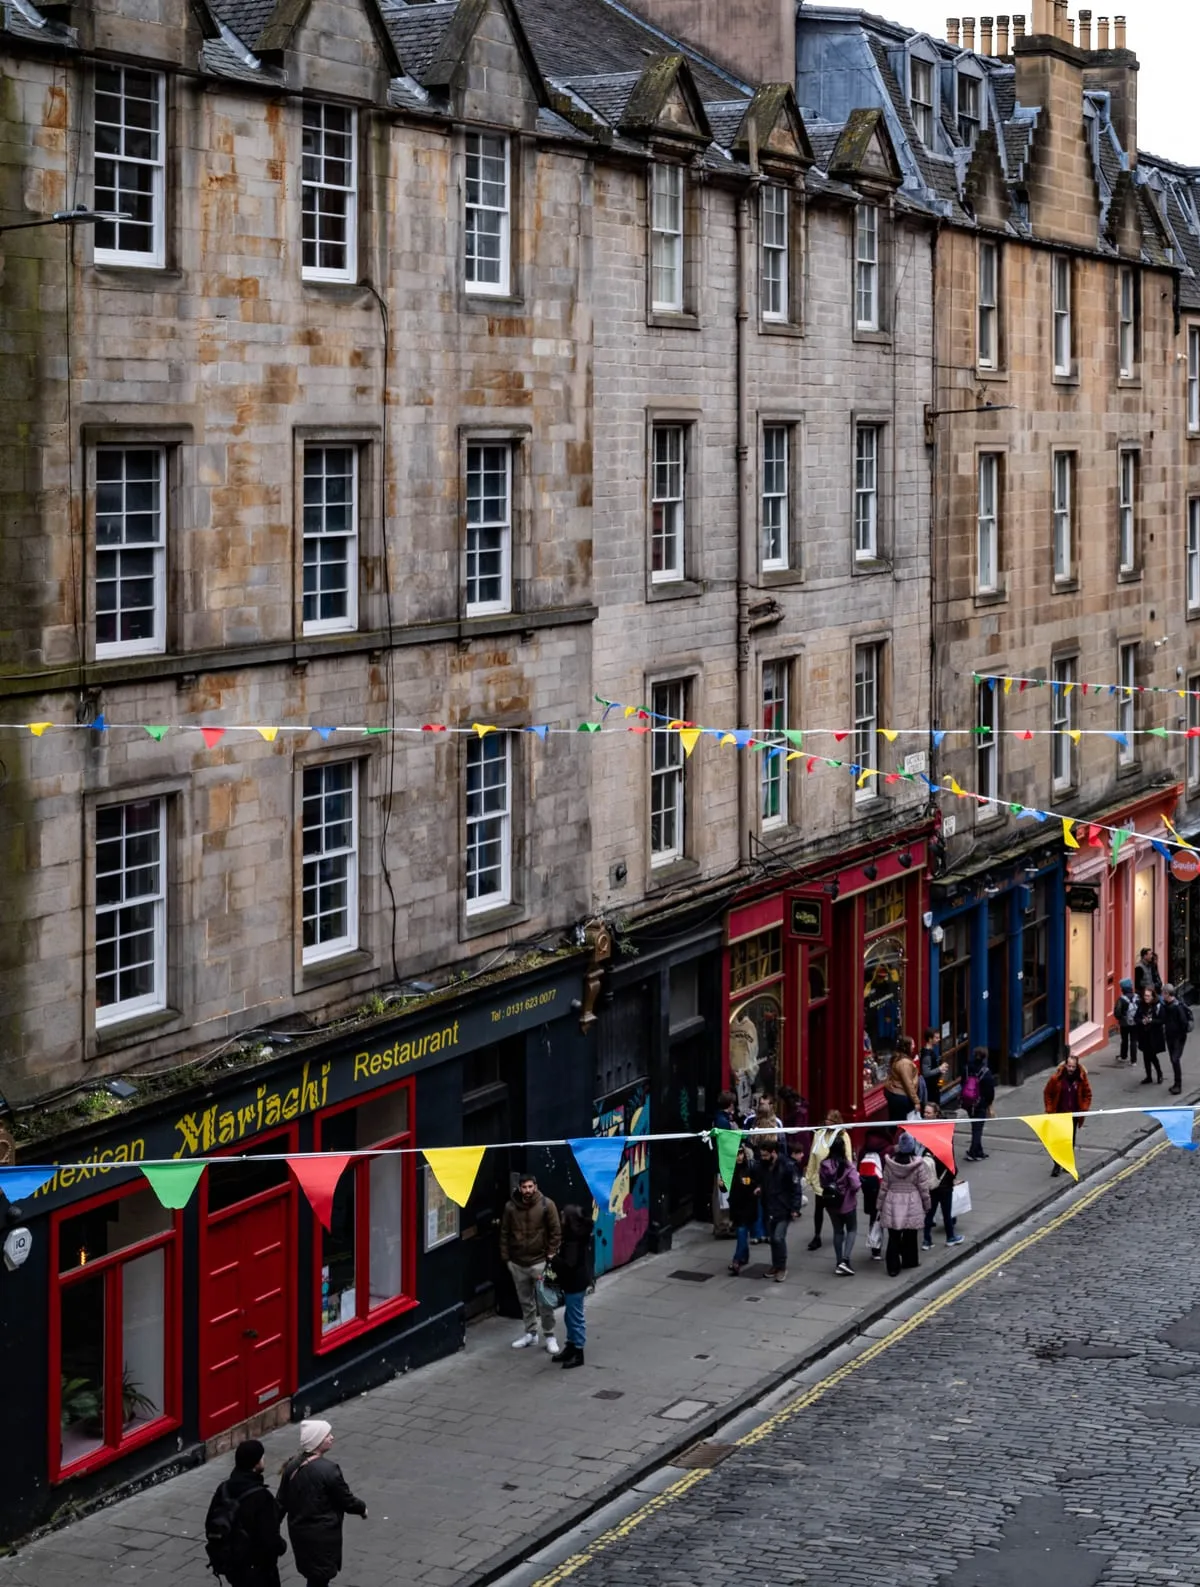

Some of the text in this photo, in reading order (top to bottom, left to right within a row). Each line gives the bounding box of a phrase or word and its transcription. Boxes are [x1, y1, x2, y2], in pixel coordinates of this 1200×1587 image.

[506, 1002, 523, 1016] 0131
[525, 996, 538, 1010] 623
[539, 989, 556, 1004] 0077
[173, 1060, 331, 1159] Mariachi
[353, 1019, 460, 1081] Restaurant
